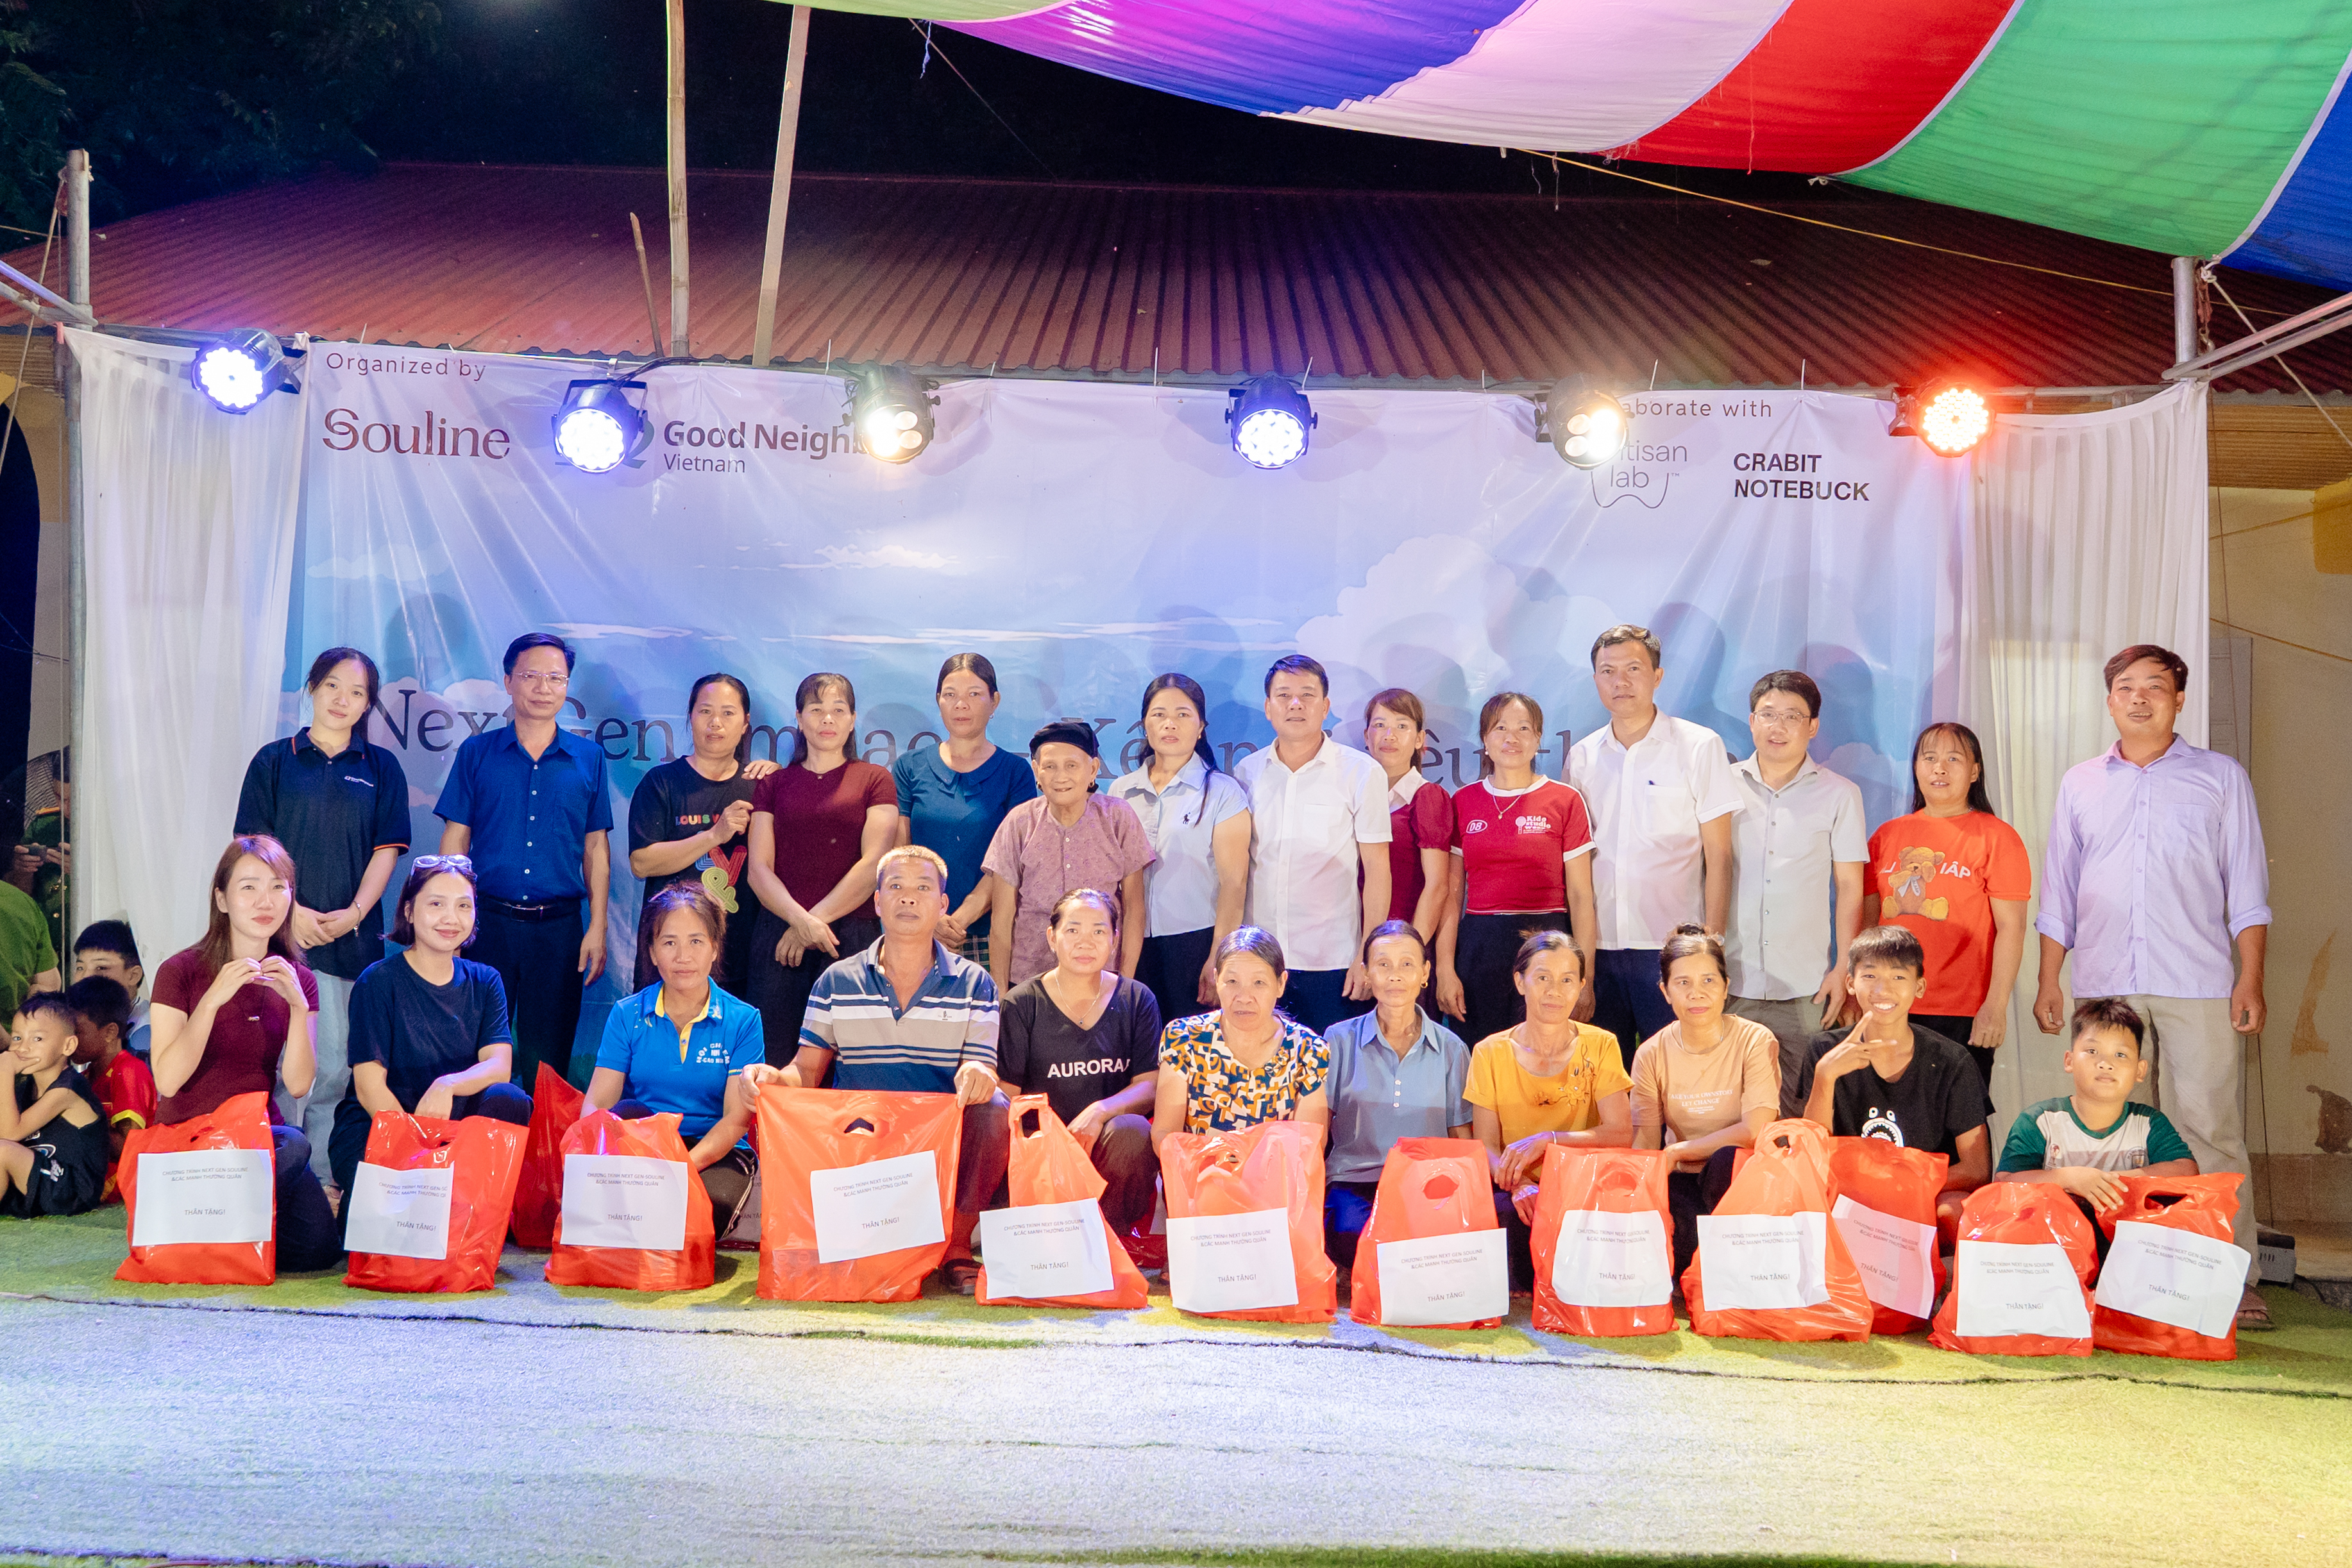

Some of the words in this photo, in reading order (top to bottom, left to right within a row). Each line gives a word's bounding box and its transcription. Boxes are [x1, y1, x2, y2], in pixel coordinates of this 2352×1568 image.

[326, 353, 448, 376] Organized
[459, 359, 486, 381] by
[1723, 400, 1772, 417] with
[323, 408, 511, 459] Souline
[664, 420, 745, 448] Good
[1621, 440, 1688, 462] tisan
[664, 453, 745, 473] Vietnam
[1733, 453, 1822, 473] CRABIT
[1611, 465, 1649, 488] lab
[1734, 479, 1870, 501] NOTEBUCK
[375, 689, 512, 752] Nex
[675, 814, 710, 825] LOUIS
